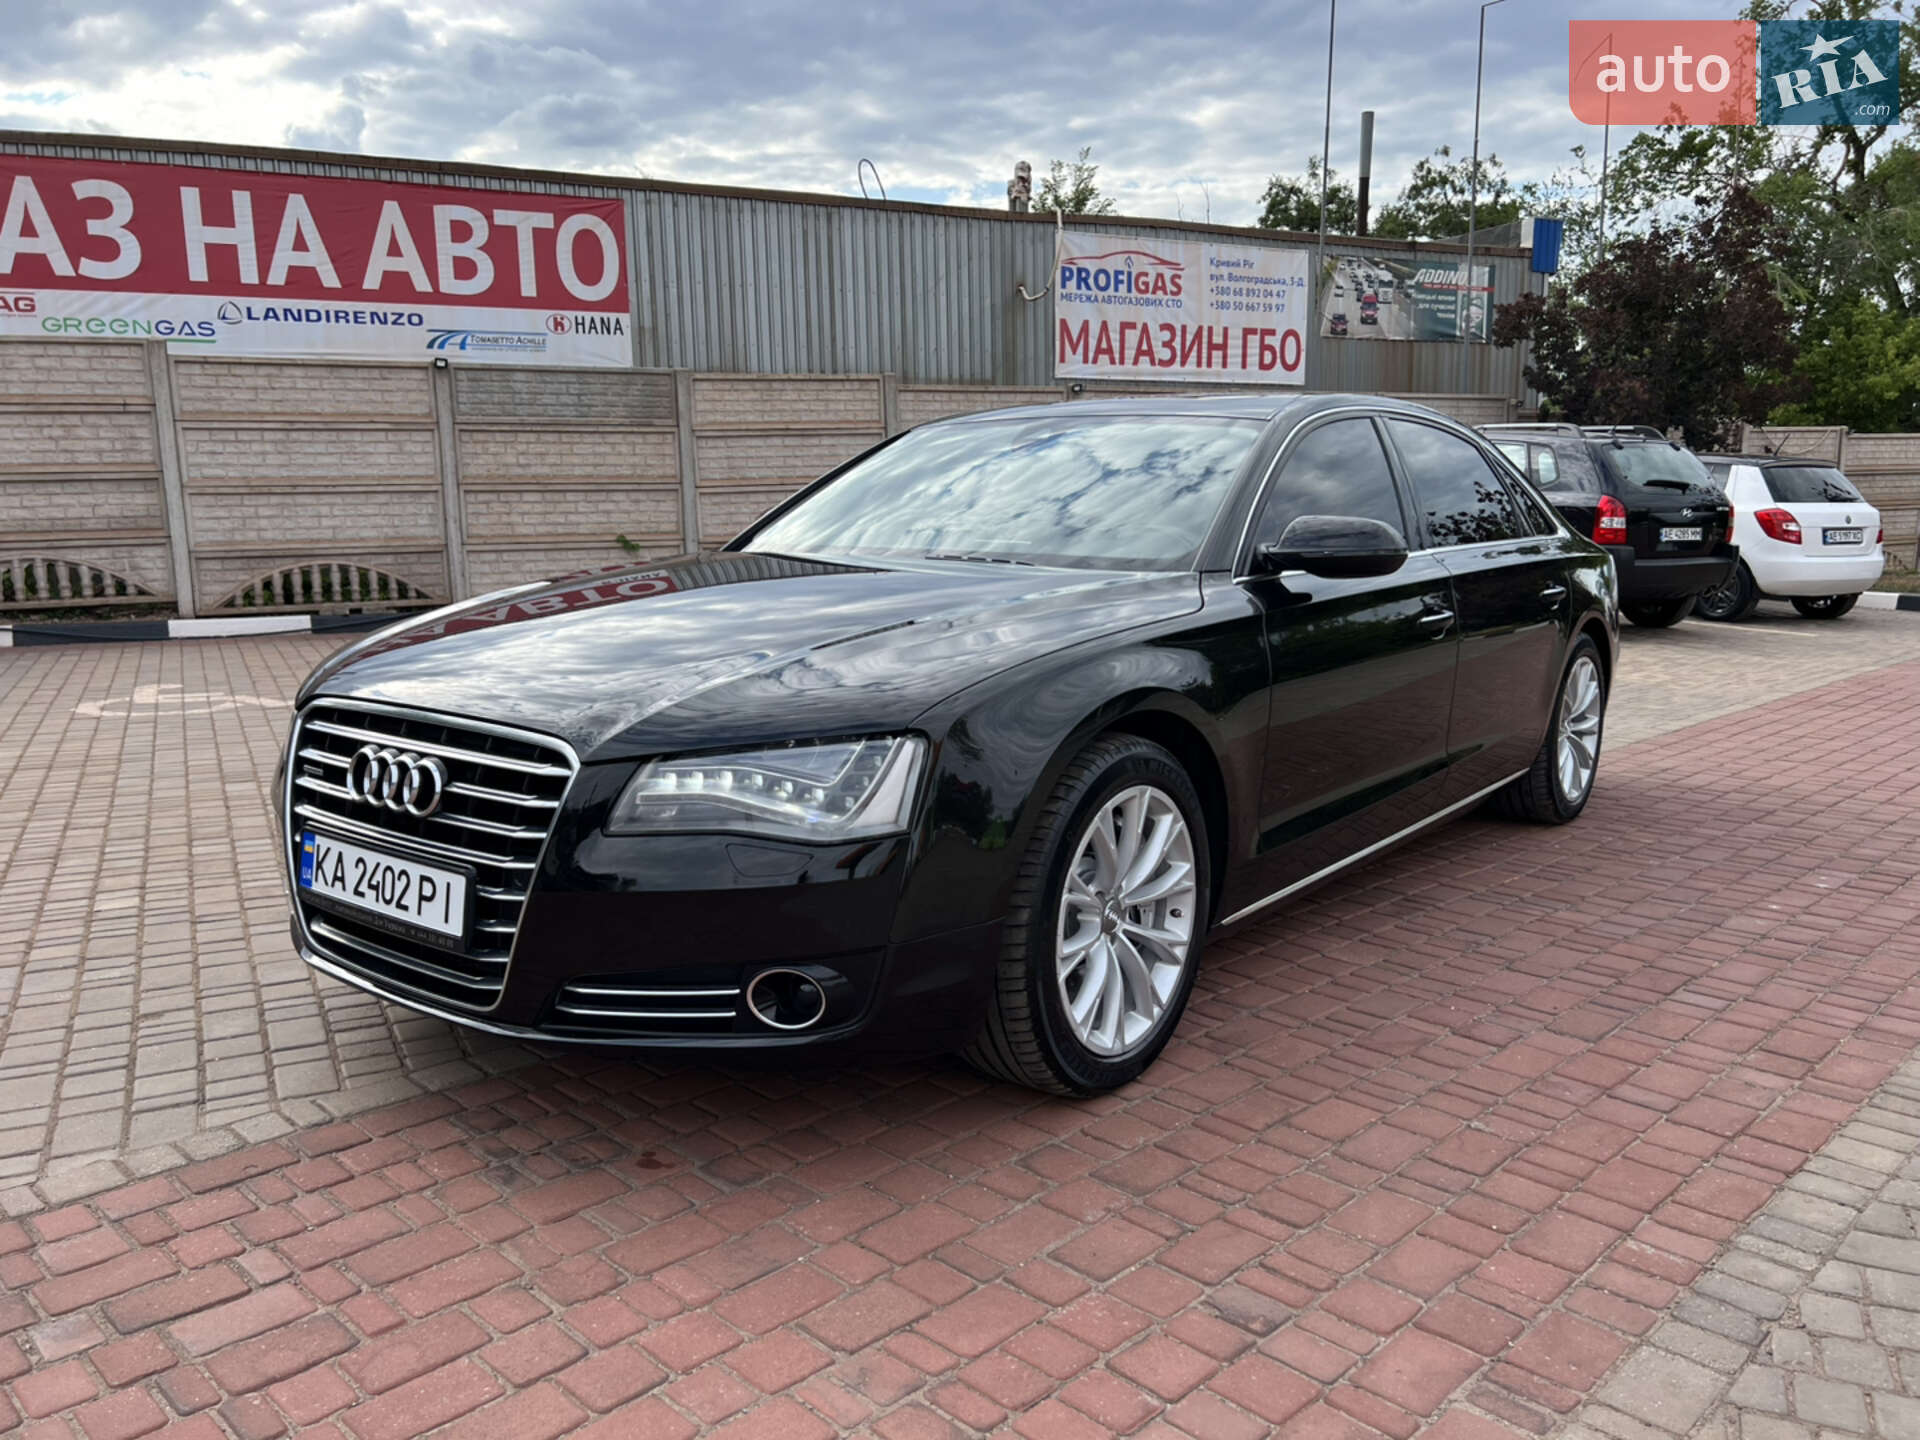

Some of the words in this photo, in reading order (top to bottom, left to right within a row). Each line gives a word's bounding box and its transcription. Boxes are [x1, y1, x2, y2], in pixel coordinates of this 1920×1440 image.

[0, 175, 143, 281] АЗ
[179, 186, 342, 289] НА
[362, 199, 620, 302] АВТО
[246, 305, 424, 327] LANDIRENZO
[1060, 292, 1099, 304] МЕРЕЖА
[1165, 298, 1182, 309] СТО
[574, 315, 624, 336] HANA
[1059, 318, 1228, 369] МАГАЗИН
[1241, 327, 1302, 373] ГБО
[315, 844, 346, 892] KA
[353, 856, 411, 912] 2402
